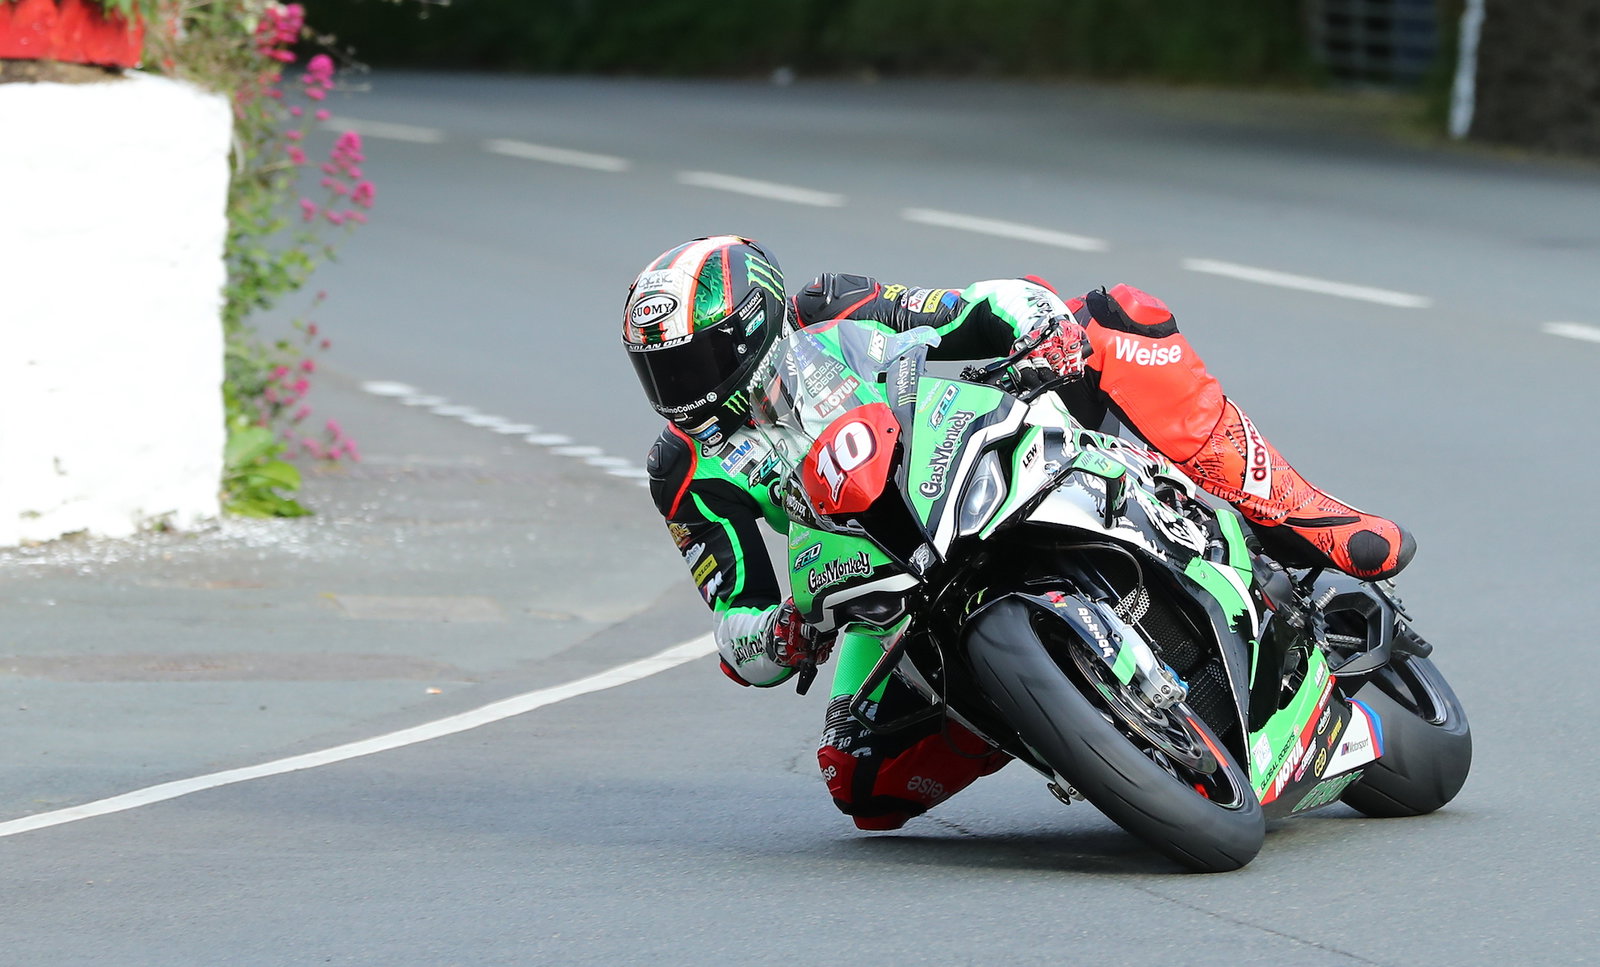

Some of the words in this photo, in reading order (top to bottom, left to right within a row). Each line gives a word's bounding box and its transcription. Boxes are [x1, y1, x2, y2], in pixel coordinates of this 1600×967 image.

[632, 303, 672, 319] SUOMY
[746, 335, 782, 393] MONSTER
[1115, 336, 1182, 366] Weise
[804, 358, 836, 389] GLOBAL
[809, 362, 844, 397] ROBOTS
[818, 378, 859, 416] MOTUL
[721, 440, 752, 472] LEW
[817, 421, 876, 503] 10
[919, 411, 975, 498] GasMonkey
[1022, 444, 1038, 468] LEW
[809, 551, 871, 594] GasMonkey
[1078, 607, 1114, 658] DUNLOP
[1261, 761, 1278, 791] GLOBAL
[1275, 737, 1304, 798] MOTUL
